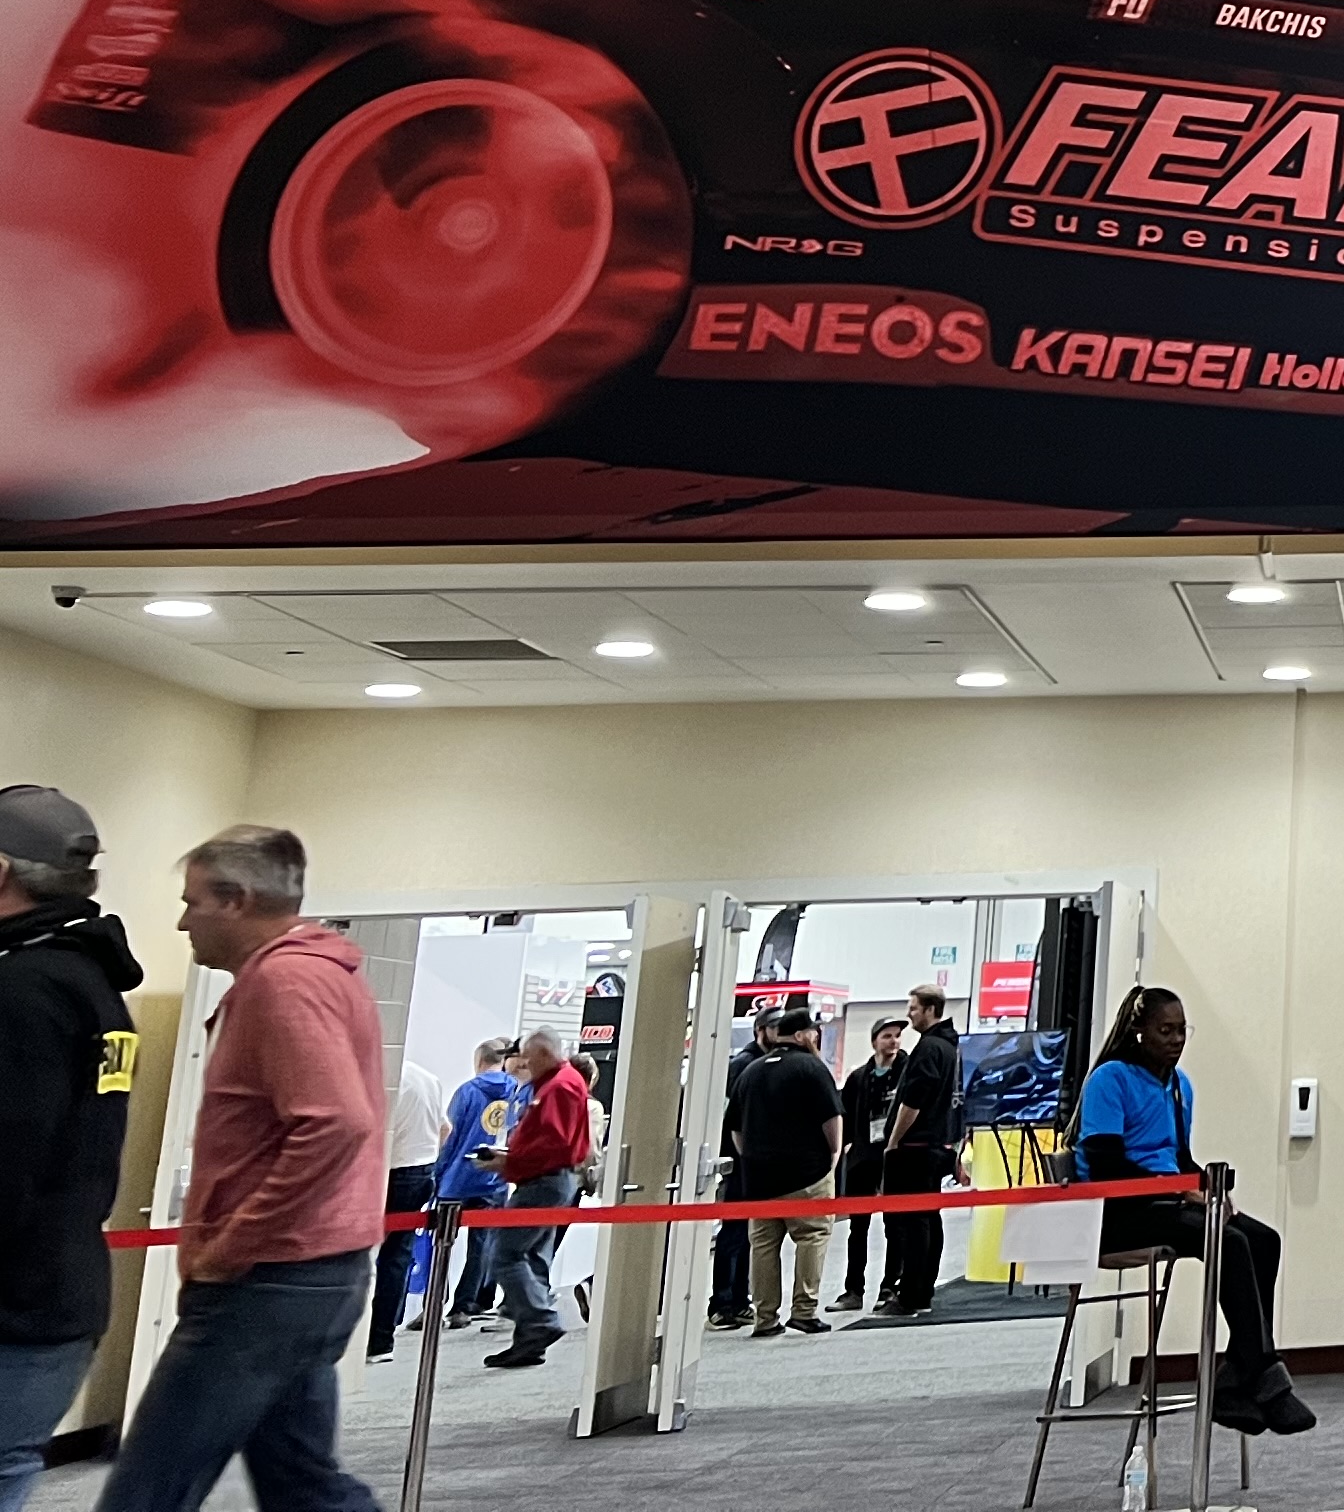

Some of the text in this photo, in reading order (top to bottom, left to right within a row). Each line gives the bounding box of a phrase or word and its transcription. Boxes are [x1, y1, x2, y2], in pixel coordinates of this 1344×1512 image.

[1215, 3, 1327, 39] BAKCHIS
[688, 301, 986, 365] ENEOS
[1010, 327, 1253, 391] KANSEI
